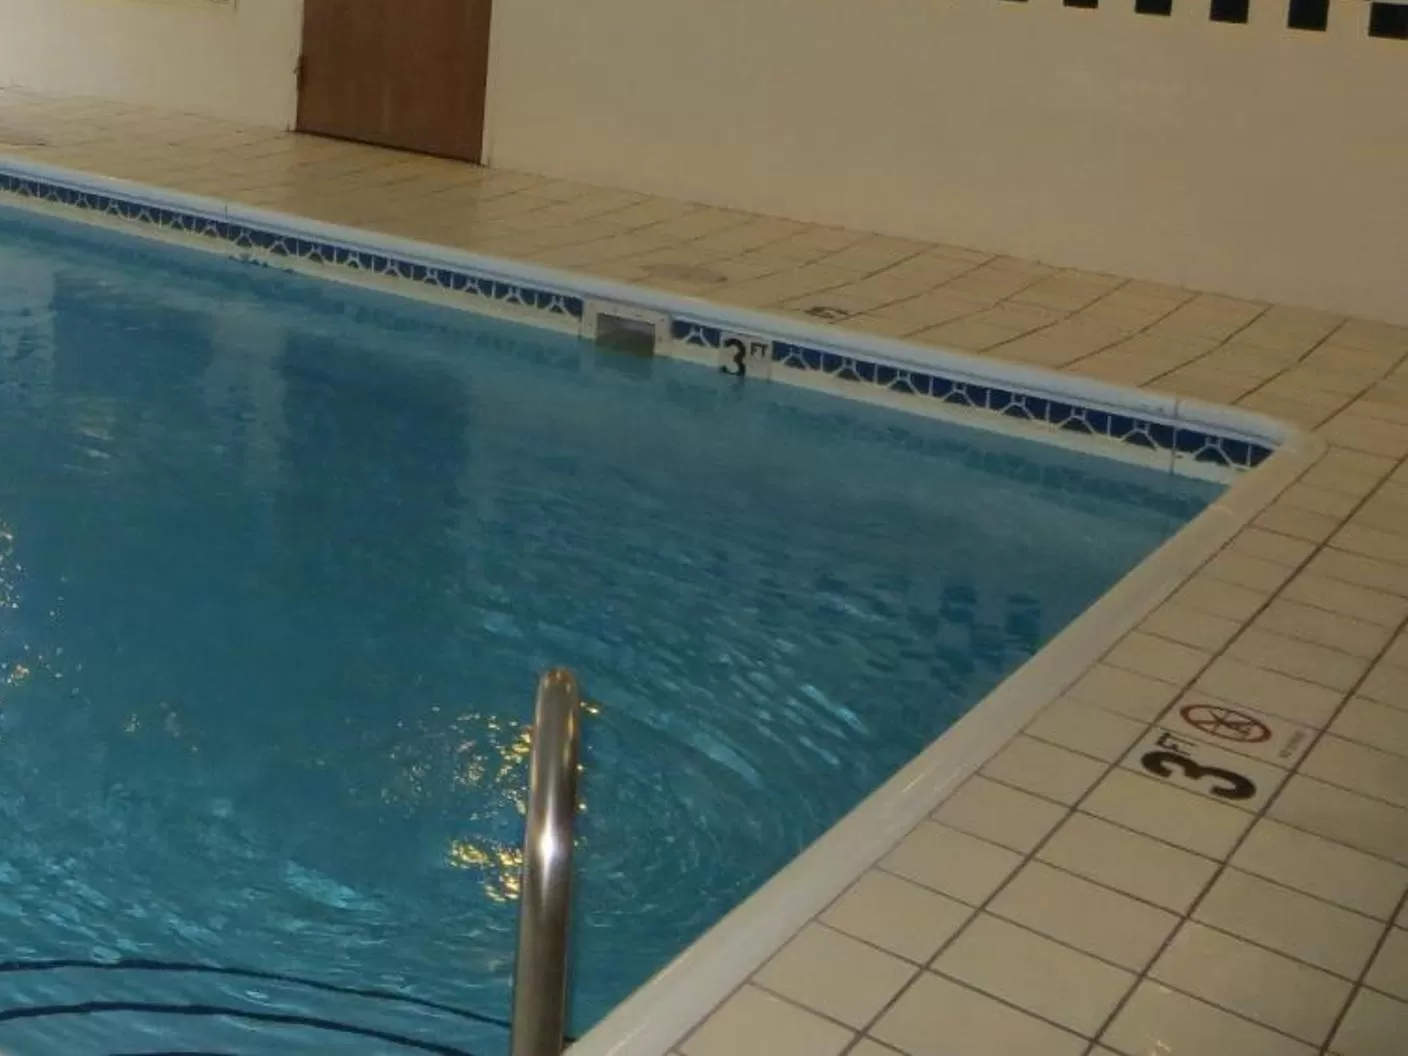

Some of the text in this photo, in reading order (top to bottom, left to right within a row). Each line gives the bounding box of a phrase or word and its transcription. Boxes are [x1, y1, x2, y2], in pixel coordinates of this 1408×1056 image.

[720, 338, 766, 376] 3 FT
[1141, 751, 1257, 800] 3
